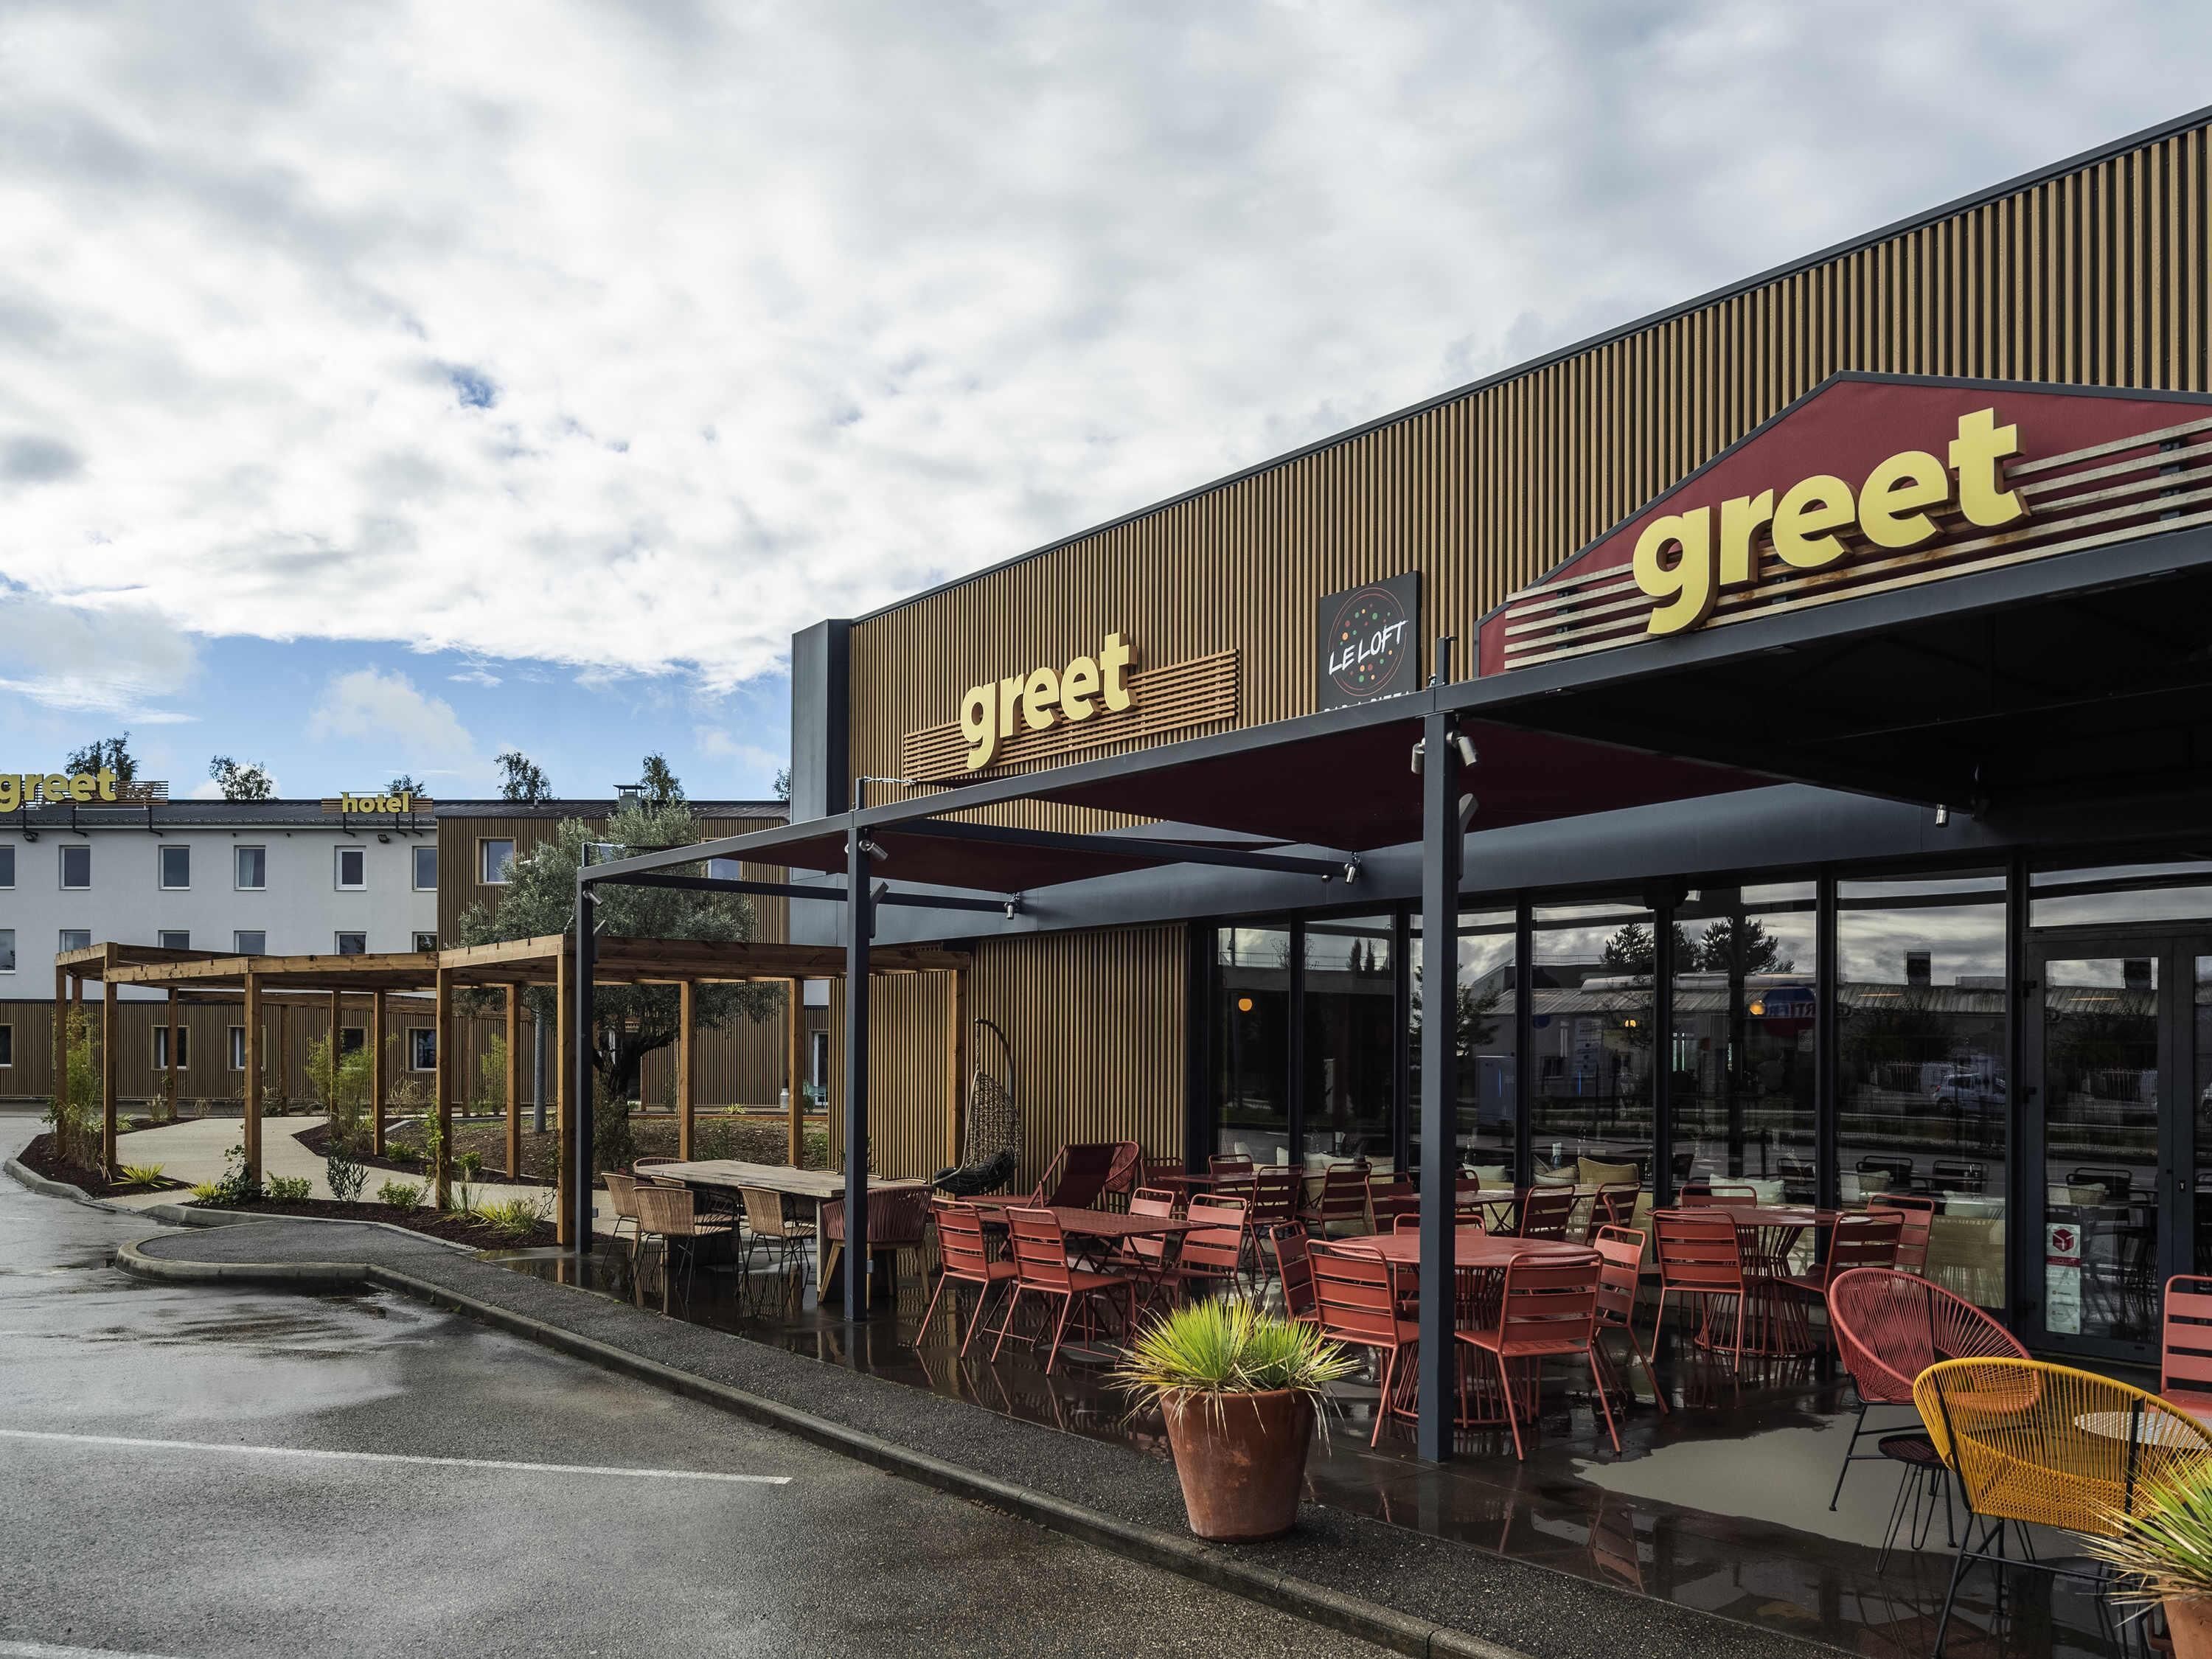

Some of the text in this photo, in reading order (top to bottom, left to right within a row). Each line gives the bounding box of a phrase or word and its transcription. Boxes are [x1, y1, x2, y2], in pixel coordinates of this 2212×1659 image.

[1632, 407, 2028, 636] greet
[1329, 620, 1409, 675] LE LOFT
[961, 632, 1136, 770] greet
[0, 767, 117, 813] greet
[342, 792, 410, 813] hotel
